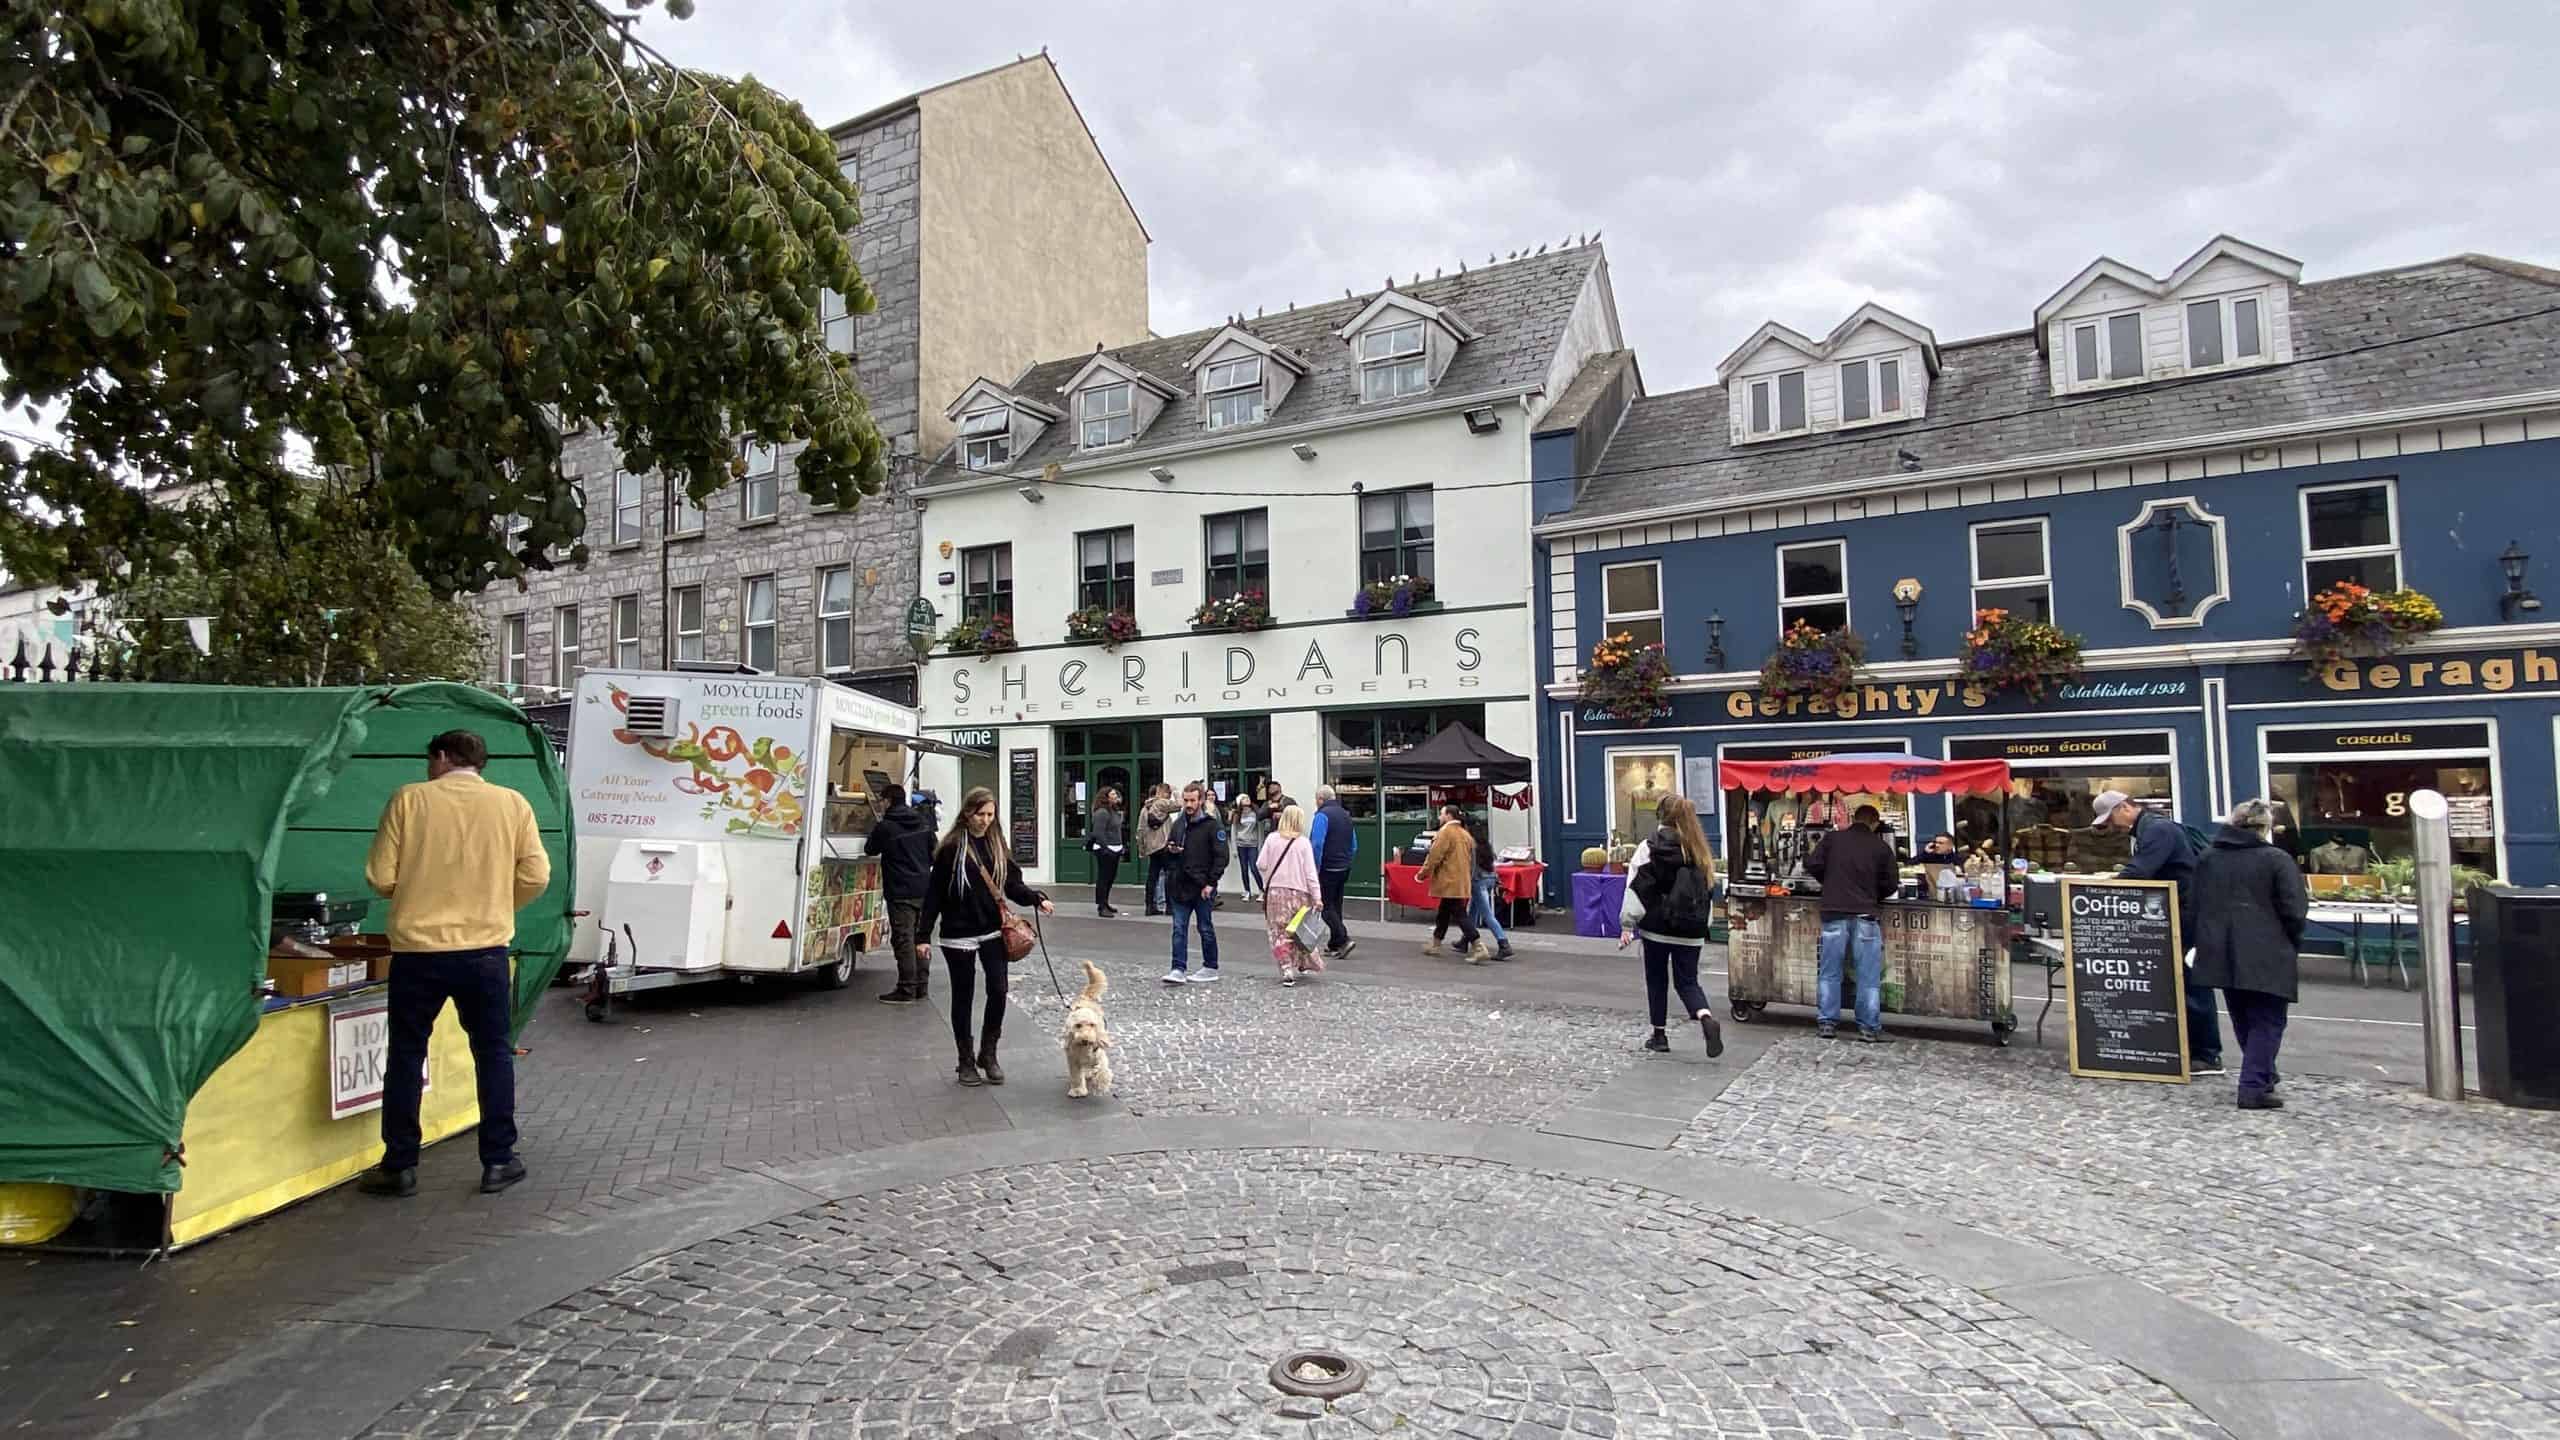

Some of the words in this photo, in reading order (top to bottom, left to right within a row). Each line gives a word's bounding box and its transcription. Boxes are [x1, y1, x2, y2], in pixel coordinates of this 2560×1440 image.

[703, 683, 805, 700] MOYCULLEN
[954, 676, 1480, 717] CHEESEMONGERS
[2059, 681, 2149, 700] Established
[701, 703, 750, 721] green
[757, 700, 804, 720] foods
[952, 730, 992, 745] wine
[2336, 732, 2413, 746] casuals
[587, 812, 608, 825] 085
[2072, 894, 2141, 918] Coffee
[2085, 958, 2130, 976] ICED
[338, 1047, 383, 1092] BAK
